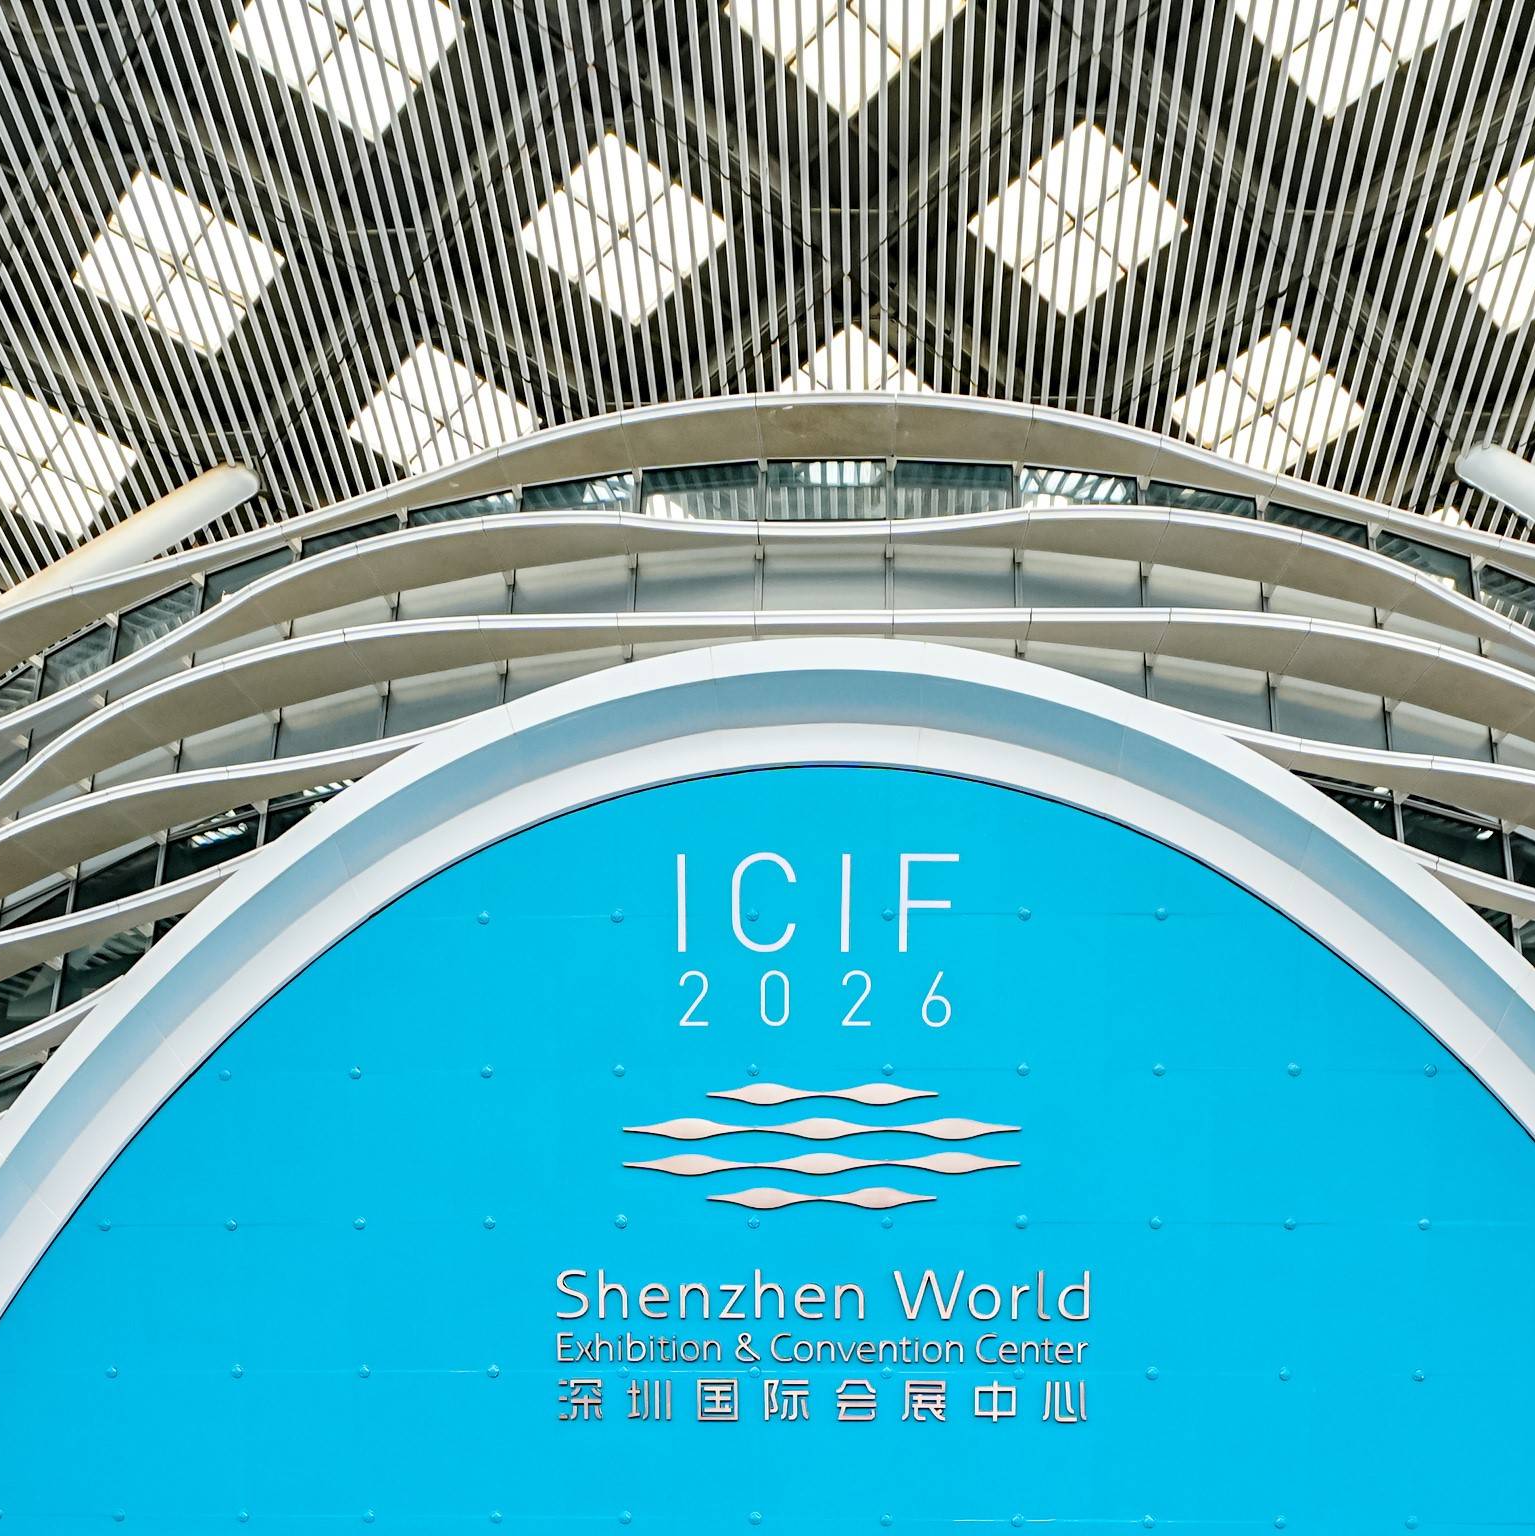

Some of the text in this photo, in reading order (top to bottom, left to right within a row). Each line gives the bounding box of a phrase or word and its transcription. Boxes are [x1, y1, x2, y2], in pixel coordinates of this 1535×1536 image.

[676, 851, 961, 953] ICIF
[678, 970, 953, 1028] 2026
[555, 1269, 1091, 1321] Shenzhen World
[555, 1332, 1090, 1364] Exhibition & Convention Center
[558, 1378, 1088, 1423] 深圳国际会展中心
